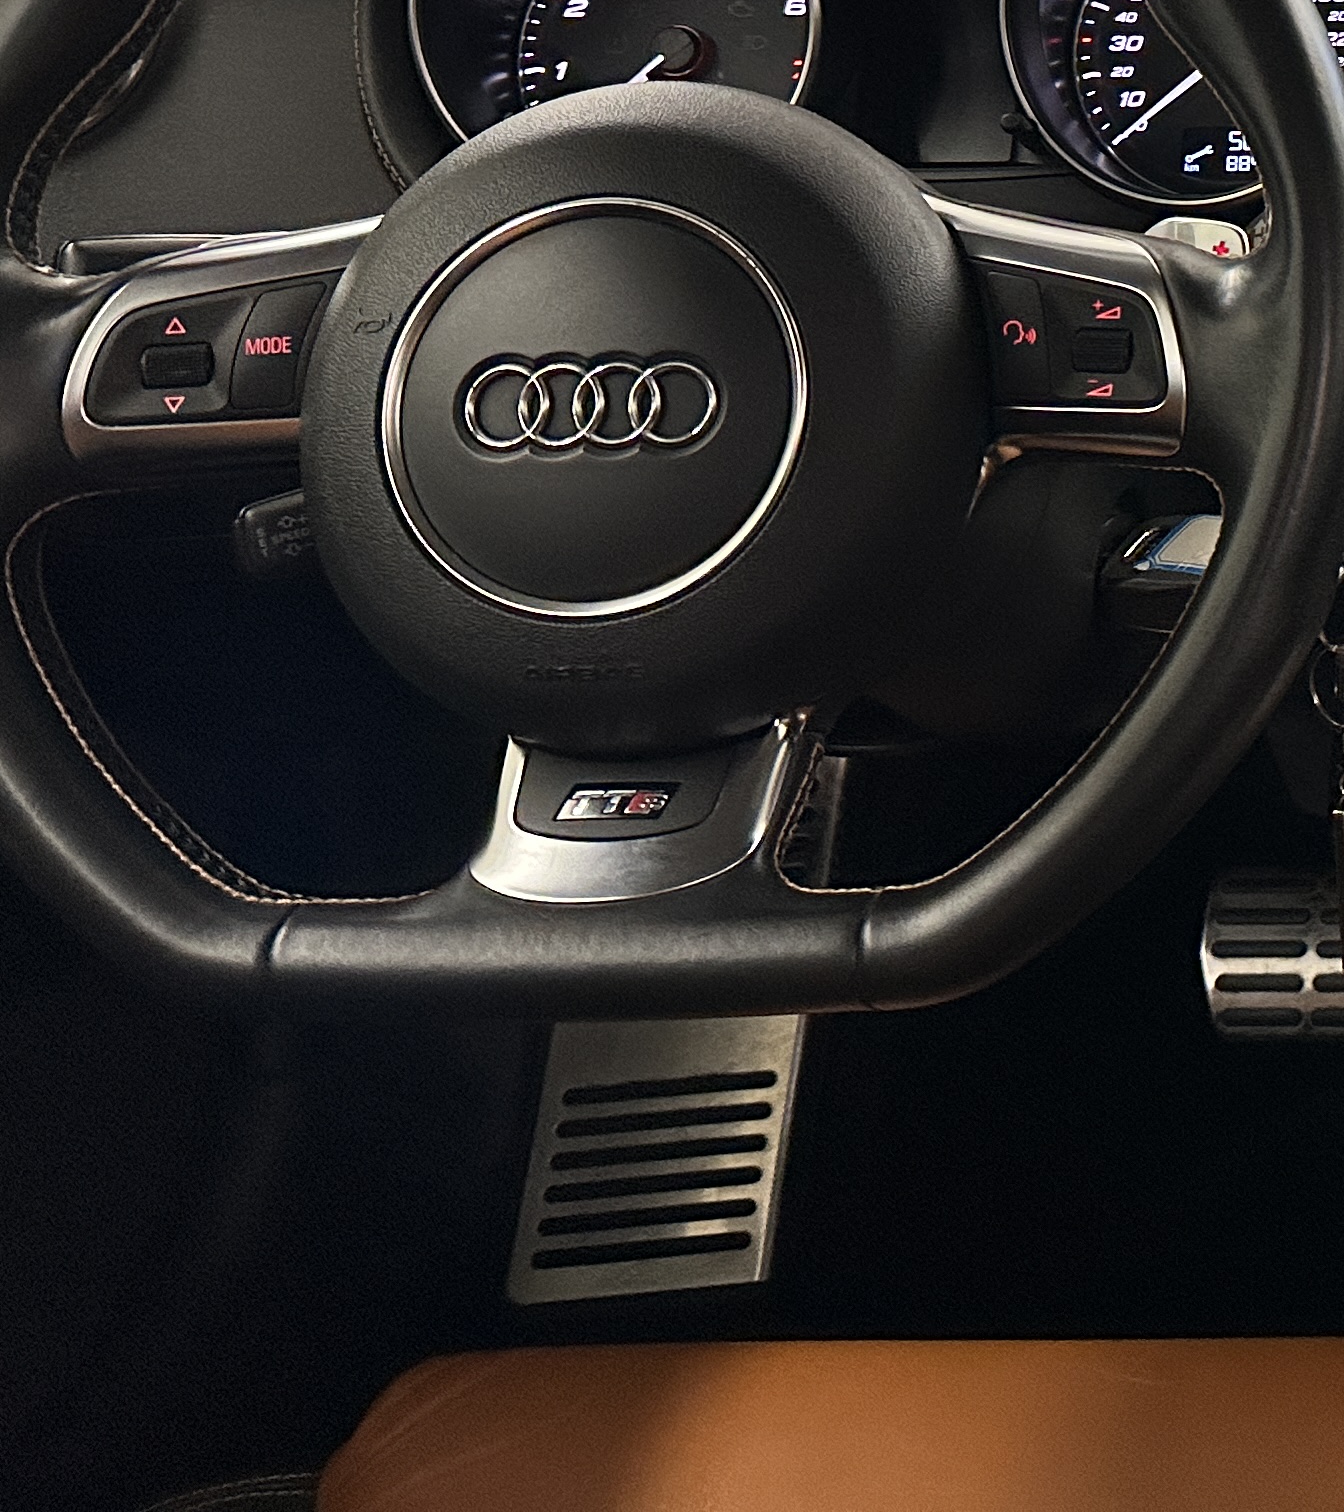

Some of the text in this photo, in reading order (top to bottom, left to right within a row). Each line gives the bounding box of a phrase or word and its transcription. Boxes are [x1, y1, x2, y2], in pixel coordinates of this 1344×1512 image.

[563, 0, 589, 18] 2
[1114, 11, 1138, 23] 40
[1108, 35, 1145, 51] 30
[554, 61, 569, 80] 1
[1110, 66, 1135, 78] 20
[1119, 90, 1146, 107] 10
[245, 336, 293, 356] MODE
